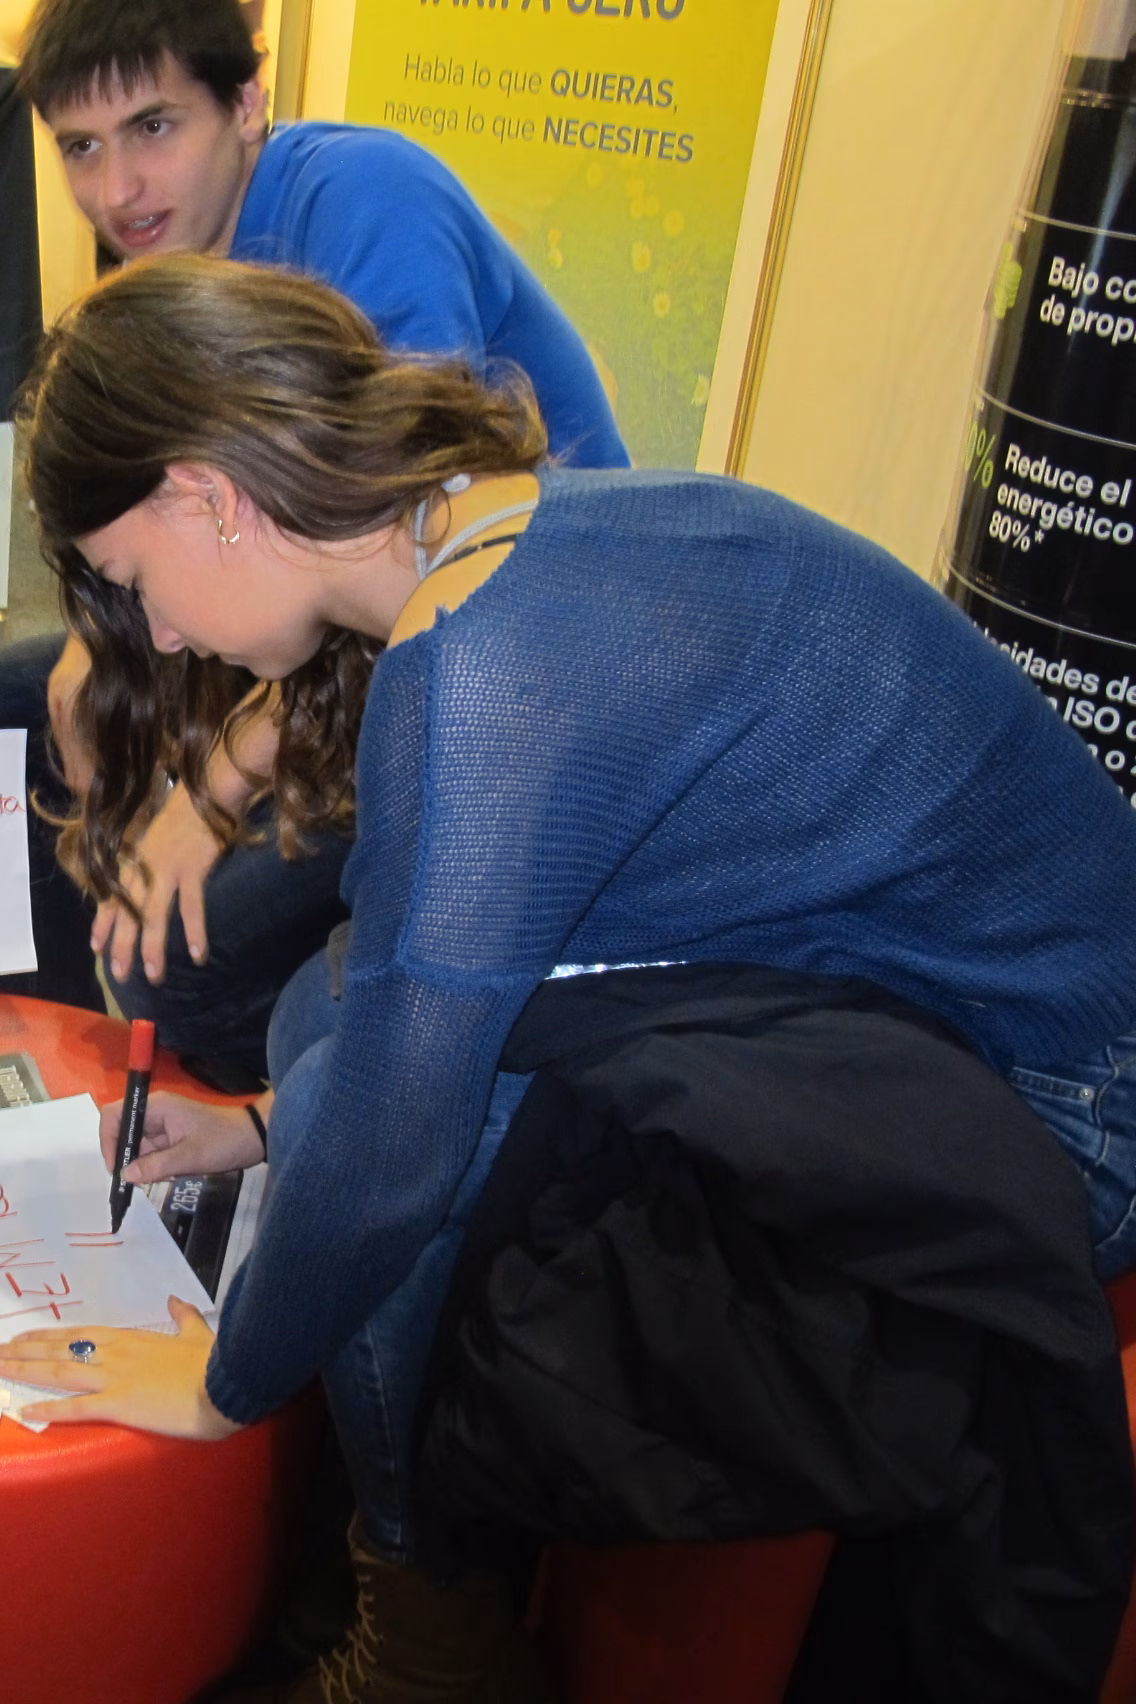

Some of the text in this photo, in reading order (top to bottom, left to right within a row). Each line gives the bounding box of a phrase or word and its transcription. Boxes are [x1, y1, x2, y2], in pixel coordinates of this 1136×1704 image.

[404, 52, 678, 116] Habla lo que QUIERAS,
[384, 100, 695, 163] navega lo que NECESITES
[1048, 256, 1100, 298] Bajo
[1039, 293, 1066, 326] de
[1005, 442, 1132, 508] Reduce el
[997, 483, 1134, 545] energético
[1063, 697, 1120, 734] ISO
[132, 1086, 140, 1109] marker
[127, 1110, 138, 1144] permanent
